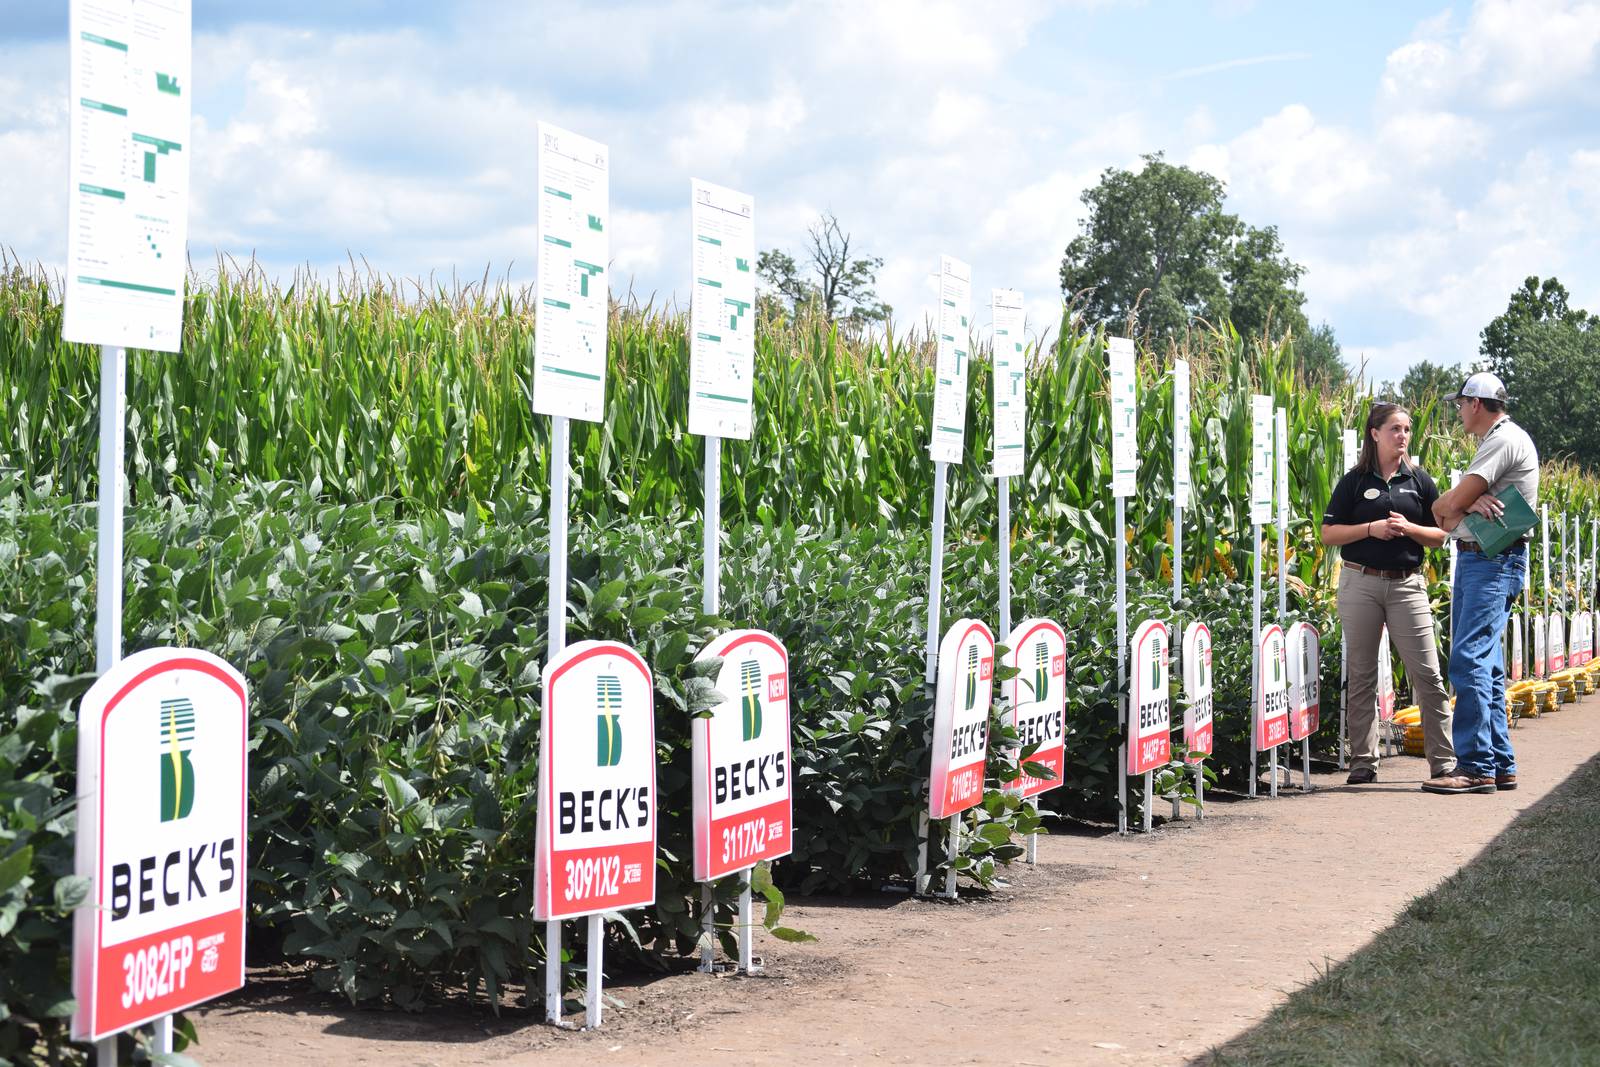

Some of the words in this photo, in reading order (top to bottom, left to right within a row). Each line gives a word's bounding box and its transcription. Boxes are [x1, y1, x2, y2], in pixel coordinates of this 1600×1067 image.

[769, 679, 785, 697] NEW
[981, 661, 991, 678] NEW
[1053, 660, 1064, 677] NEW
[1018, 710, 1062, 746] BECK'S
[1140, 698, 1168, 729] BECK'S
[951, 720, 987, 759] BECK'S
[715, 751, 785, 805] BECK'S
[560, 786, 649, 835] BECK'S
[722, 817, 766, 864] 3117X2
[111, 837, 236, 922] BECK'S
[564, 855, 621, 901] 3091X2
[121, 934, 194, 1010] 3082FP
